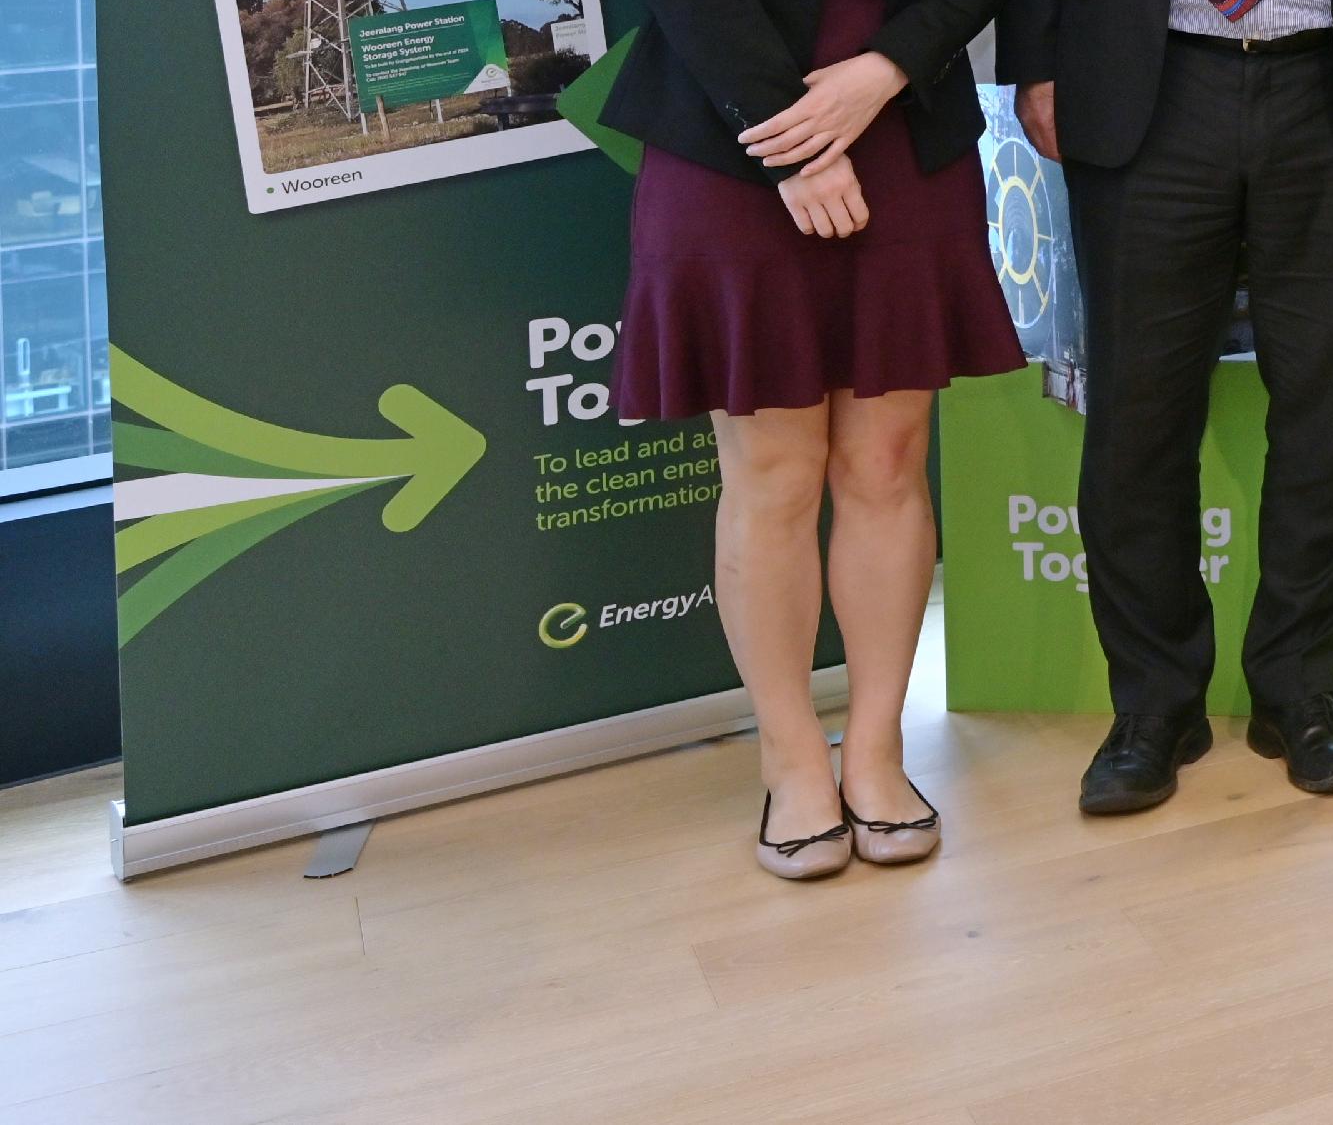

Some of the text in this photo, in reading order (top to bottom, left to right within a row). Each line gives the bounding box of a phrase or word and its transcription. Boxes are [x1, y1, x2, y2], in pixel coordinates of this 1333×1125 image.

[405, 20, 433, 30] Power
[434, 15, 465, 25] Station
[282, 169, 363, 194] Wooreen
[534, 454, 567, 474] To
[575, 442, 629, 469] lead
[637, 432, 685, 459] and
[535, 456, 720, 504] the clean ener
